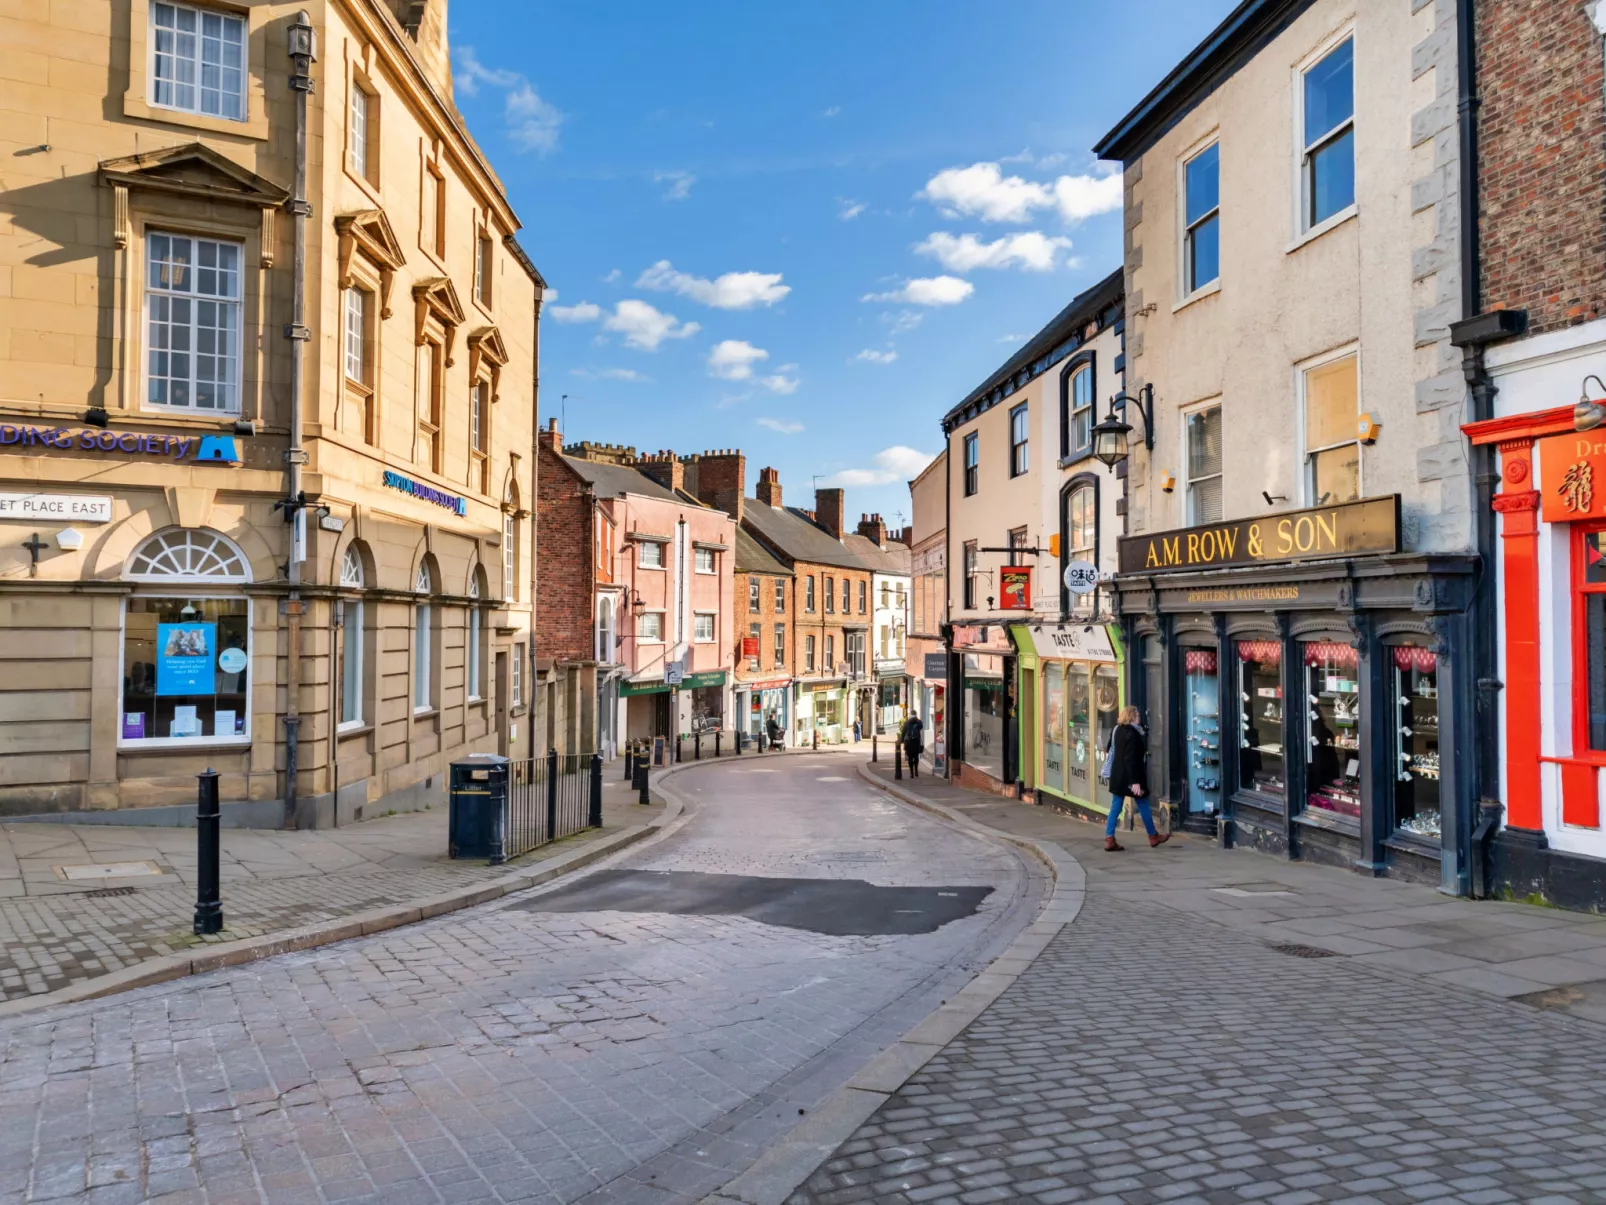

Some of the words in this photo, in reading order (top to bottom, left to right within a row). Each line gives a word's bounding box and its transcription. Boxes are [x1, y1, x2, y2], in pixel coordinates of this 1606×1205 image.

[23, 501, 63, 513] PLACE
[72, 503, 106, 514] EAST
[1187, 526, 1239, 565] ROW
[1248, 524, 1264, 557] &
[1277, 512, 1337, 554] SON
[1188, 590, 1228, 603] JEWELLERS
[1229, 591, 1235, 601] &
[1236, 586, 1299, 601] WATCHMAKERS
[1052, 634, 1075, 647] TASTE
[1046, 759, 1060, 771] TASTE
[1071, 767, 1086, 780] TASTE
[1098, 775, 1109, 787] TAS
